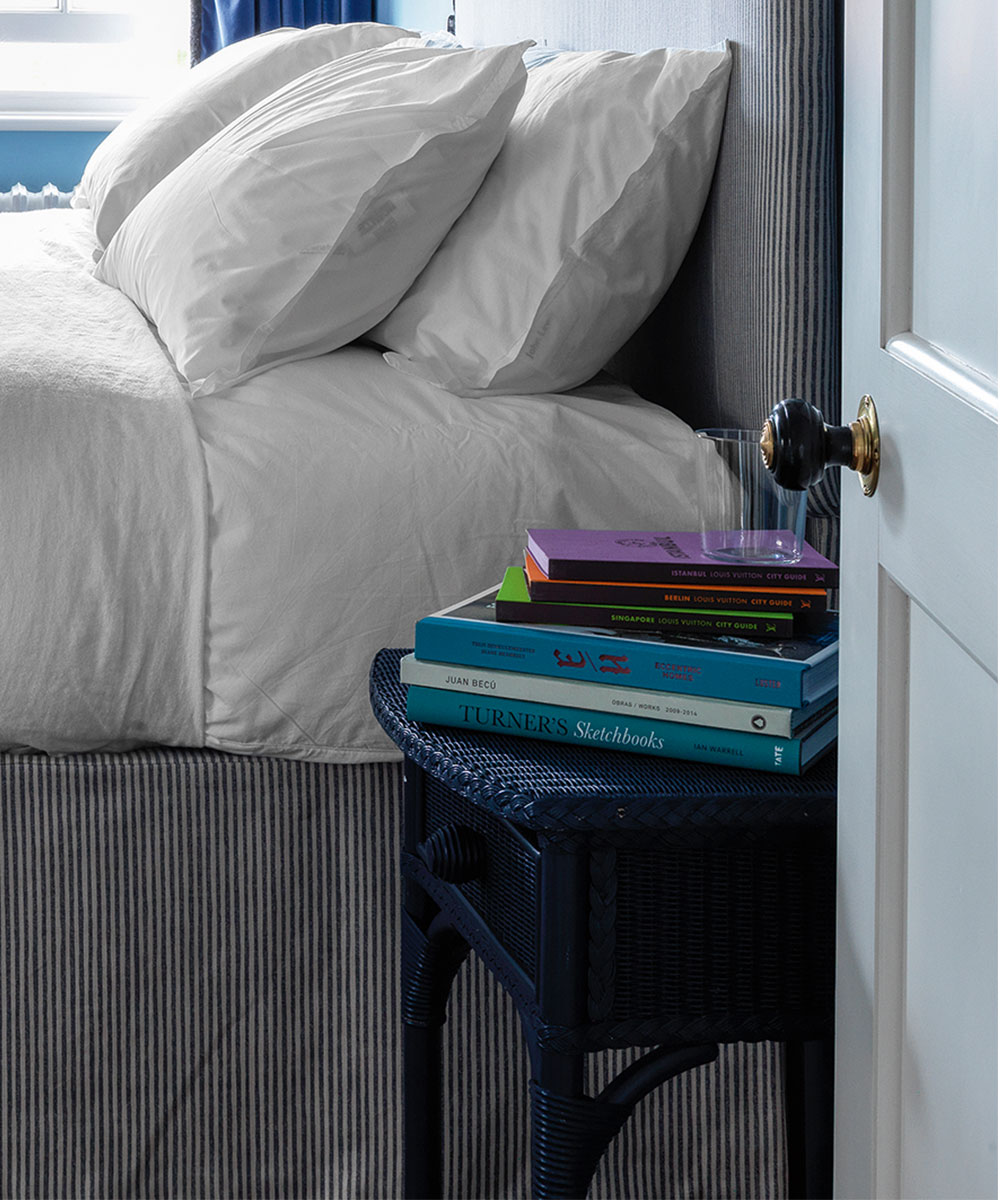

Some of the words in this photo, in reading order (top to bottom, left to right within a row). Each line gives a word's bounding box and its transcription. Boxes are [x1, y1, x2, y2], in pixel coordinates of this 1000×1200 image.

[671, 570, 707, 578] ISTANBUL
[784, 573, 807, 581] GUIDE
[664, 594, 691, 602] BERLIN
[694, 595, 715, 603] LOUIS
[751, 598, 767, 606] CITY
[769, 599, 793, 607] GUIDE
[611, 615, 655, 623] SINGAPORE
[658, 617, 679, 625] LOUIS
[681, 619, 712, 627] VUITTON
[715, 621, 733, 629] CITY
[734, 622, 758, 630] GUIDE
[655, 662, 702, 674] ECCENTRIC
[445, 675, 469, 686] JUAN
[472, 679, 497, 690] BECÚ
[662, 671, 694, 682] HOMES
[612, 699, 633, 708] OBRAS
[638, 703, 661, 712] WORKS
[665, 707, 698, 717] 2009-2014
[459, 704, 568, 736] TURNER'S
[573, 720, 665, 750] Sketchbooks
[694, 743, 706, 751] IAN
[709, 745, 744, 757] WARRELL
[774, 745, 784, 766] TATE
